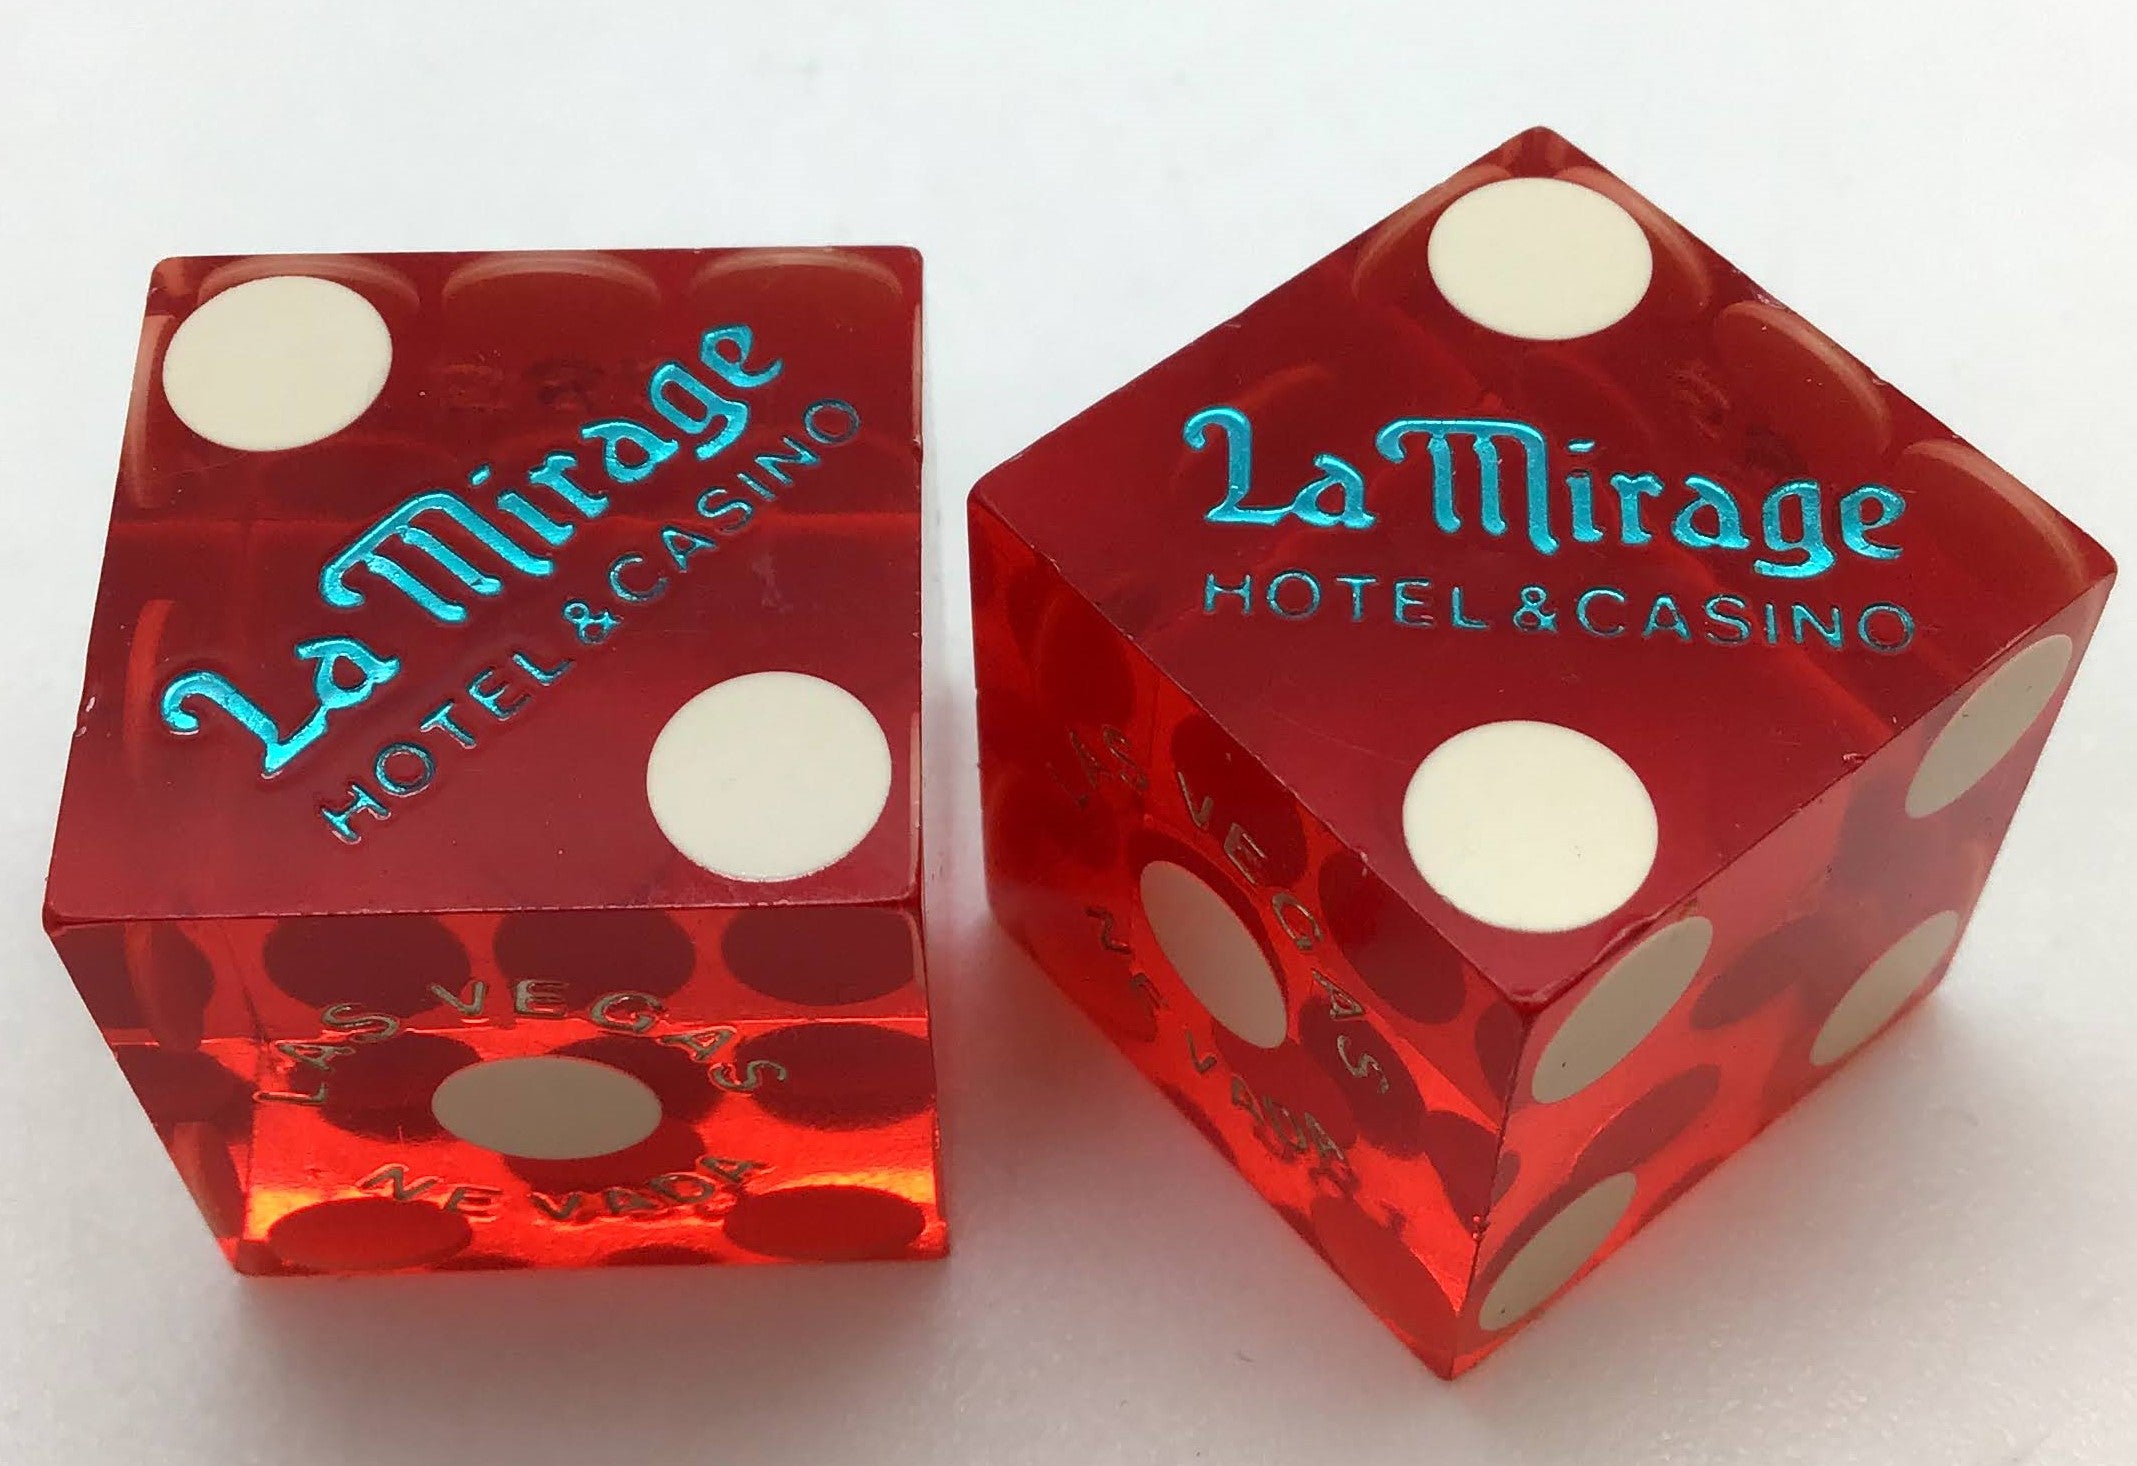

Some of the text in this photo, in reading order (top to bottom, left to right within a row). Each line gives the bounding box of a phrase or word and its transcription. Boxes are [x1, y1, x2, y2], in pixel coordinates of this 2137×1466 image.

[161, 323, 784, 778] La Mirage
[1183, 406, 1907, 580] La Mirage
[1203, 570, 1489, 630] HOTEL
[321, 648, 573, 844] HOTEL
[1176, 770, 1389, 1095] VEGAS
[252, 978, 787, 1105] LAS VEGAS
[357, 1155, 769, 1222] NEVADA
